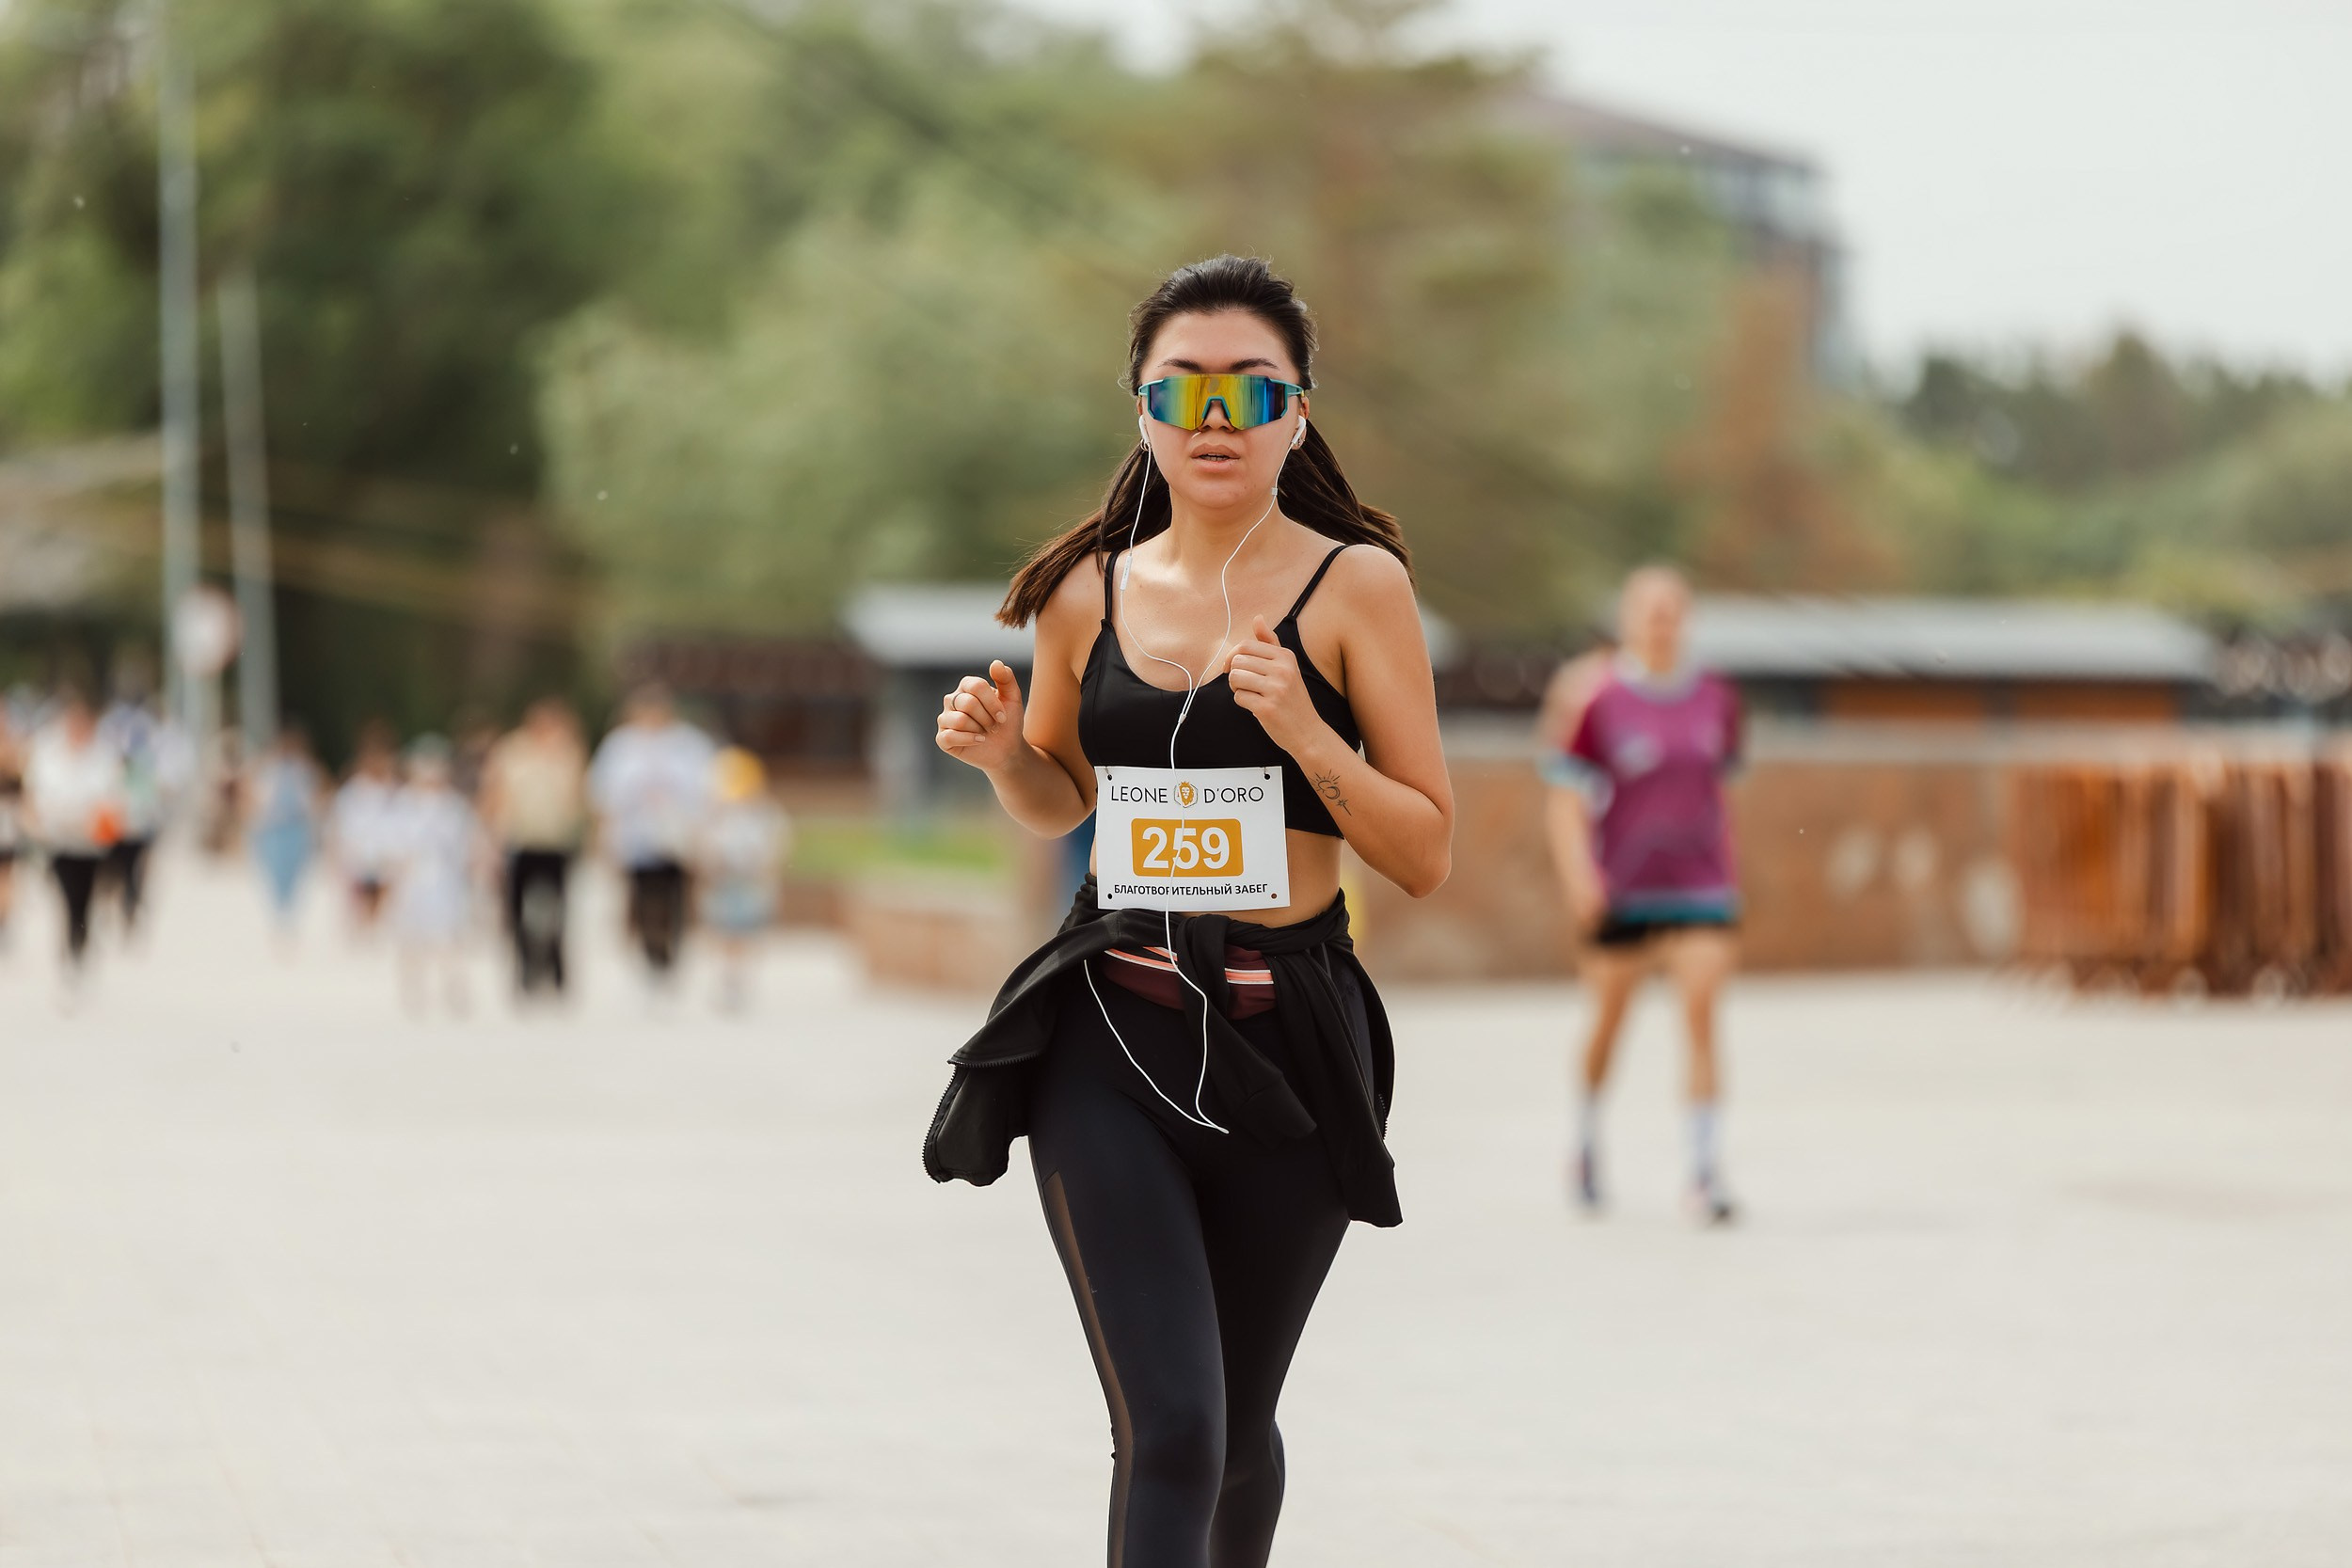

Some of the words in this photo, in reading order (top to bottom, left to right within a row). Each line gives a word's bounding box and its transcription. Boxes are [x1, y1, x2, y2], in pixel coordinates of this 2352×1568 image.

[1111, 785, 1168, 803] LEONE
[1204, 786, 1263, 803] D'ORO
[1141, 826, 1231, 870] 259
[1234, 883, 1268, 895] ЗАБЕГ
